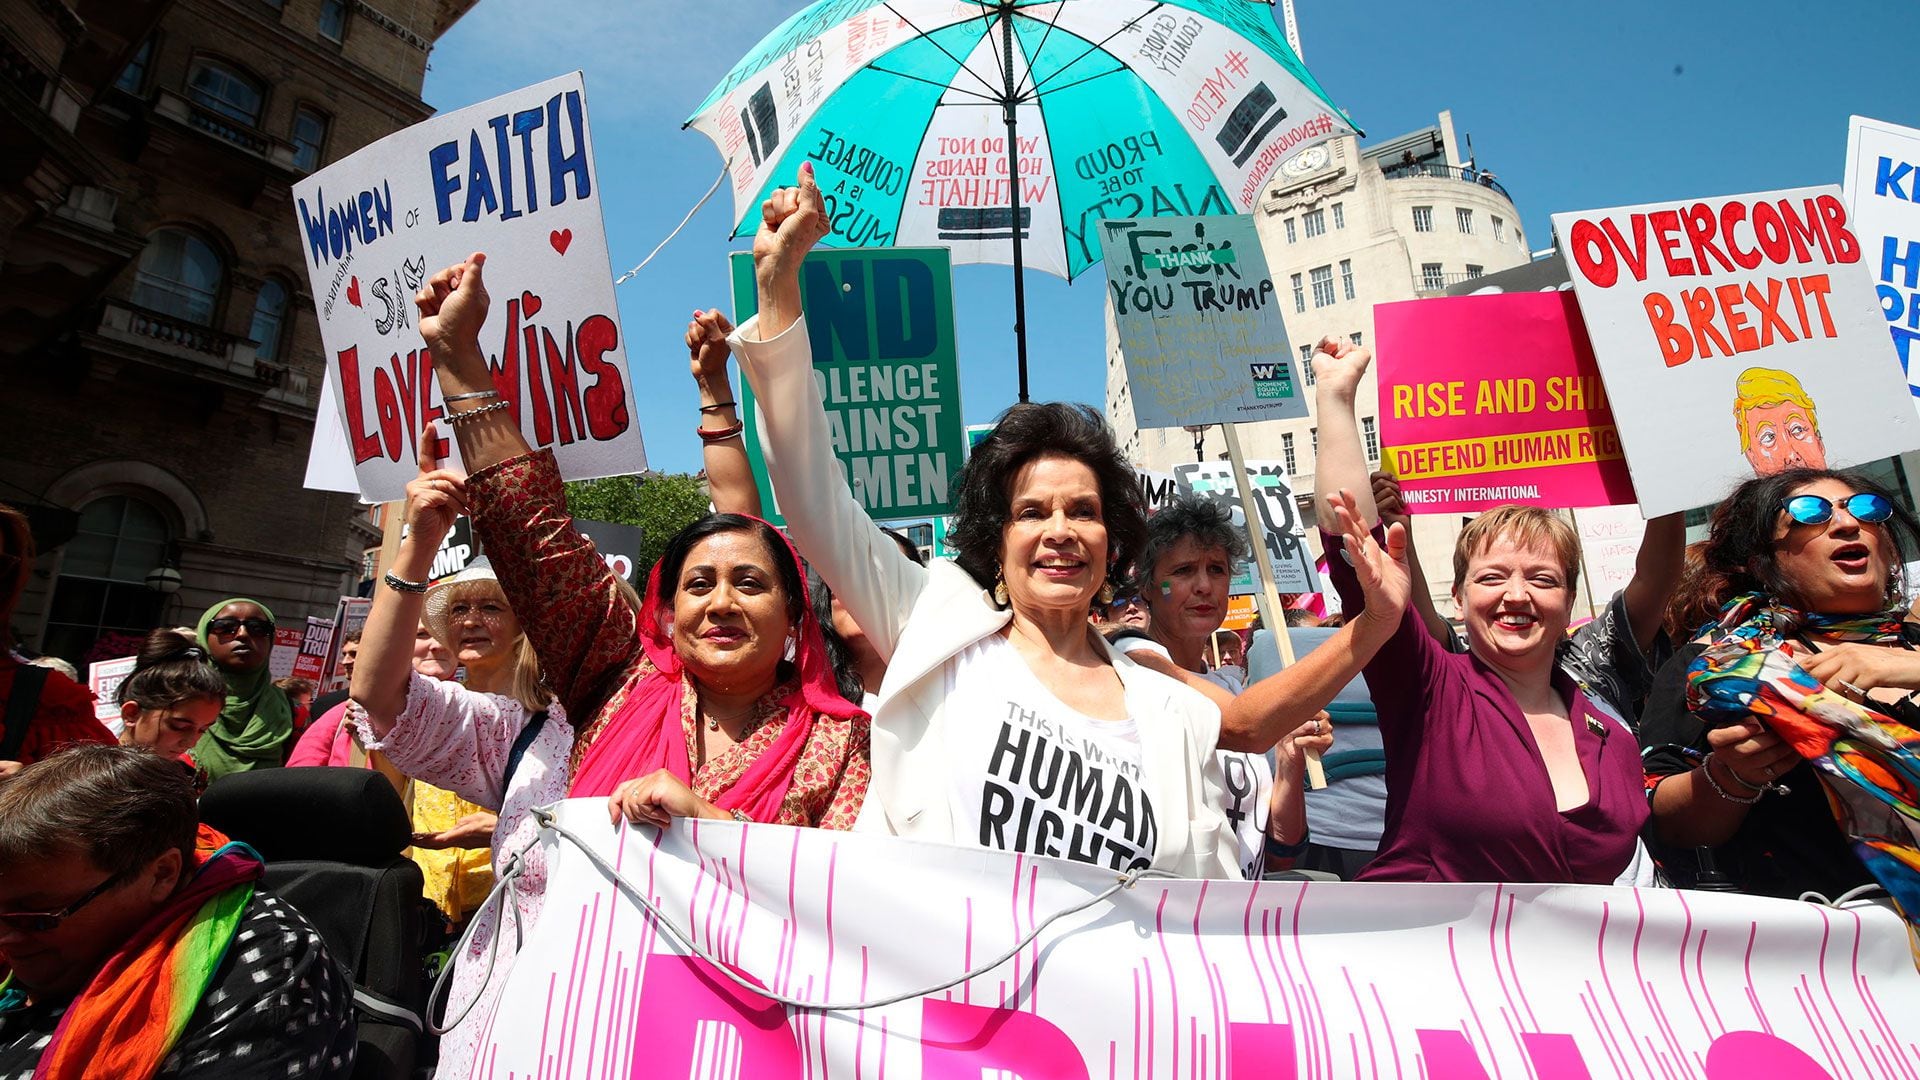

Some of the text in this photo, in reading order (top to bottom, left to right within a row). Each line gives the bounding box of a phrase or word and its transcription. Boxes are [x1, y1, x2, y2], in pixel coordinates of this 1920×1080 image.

[298, 90, 591, 269] WOMEN OF FAITH
[1155, 250, 1216, 267] THANK
[1570, 194, 1861, 288] OVERCOMB
[752, 257, 939, 363] ND
[1111, 278, 1274, 315] YOU TRUMP
[1643, 273, 1838, 368] BREXIT
[337, 344, 450, 466] LOVE
[814, 363, 940, 405] LENCE
[1392, 375, 1606, 419] RISE AND SHI
[826, 404, 942, 453] AINST
[1397, 428, 1624, 476] DEFEND HUMAN RIG
[837, 452, 949, 510] MEN
[1454, 485, 1541, 502] INTERNATIONAL
[428, 543, 471, 580] UMP
[302, 639, 328, 657] TRU
[306, 625, 331, 642] DUM
[1007, 702, 1054, 738] THIS
[988, 721, 1158, 857] HUMAN
